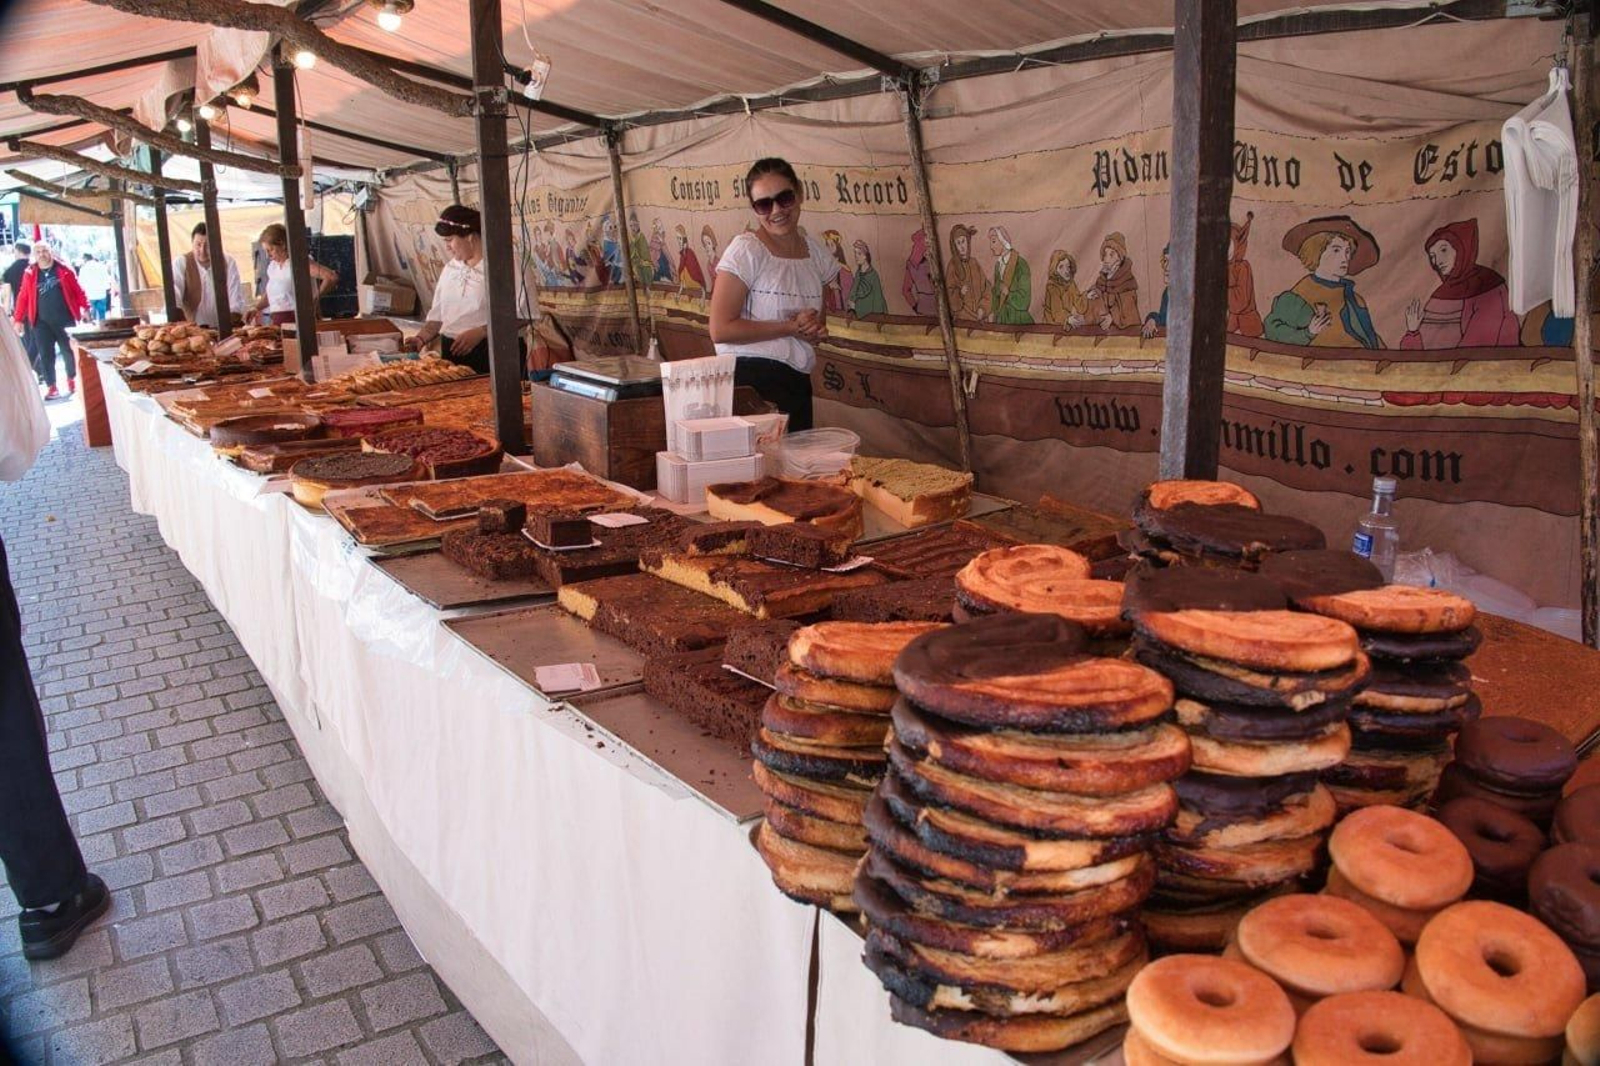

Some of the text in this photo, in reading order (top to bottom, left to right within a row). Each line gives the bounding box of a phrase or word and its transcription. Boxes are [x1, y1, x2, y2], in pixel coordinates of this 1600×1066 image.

[670, 176, 721, 205] Consiga
[835, 173, 908, 205] Record
[1091, 147, 1169, 198] Pidan
[1233, 140, 1300, 189] Uno
[1333, 151, 1374, 192] de
